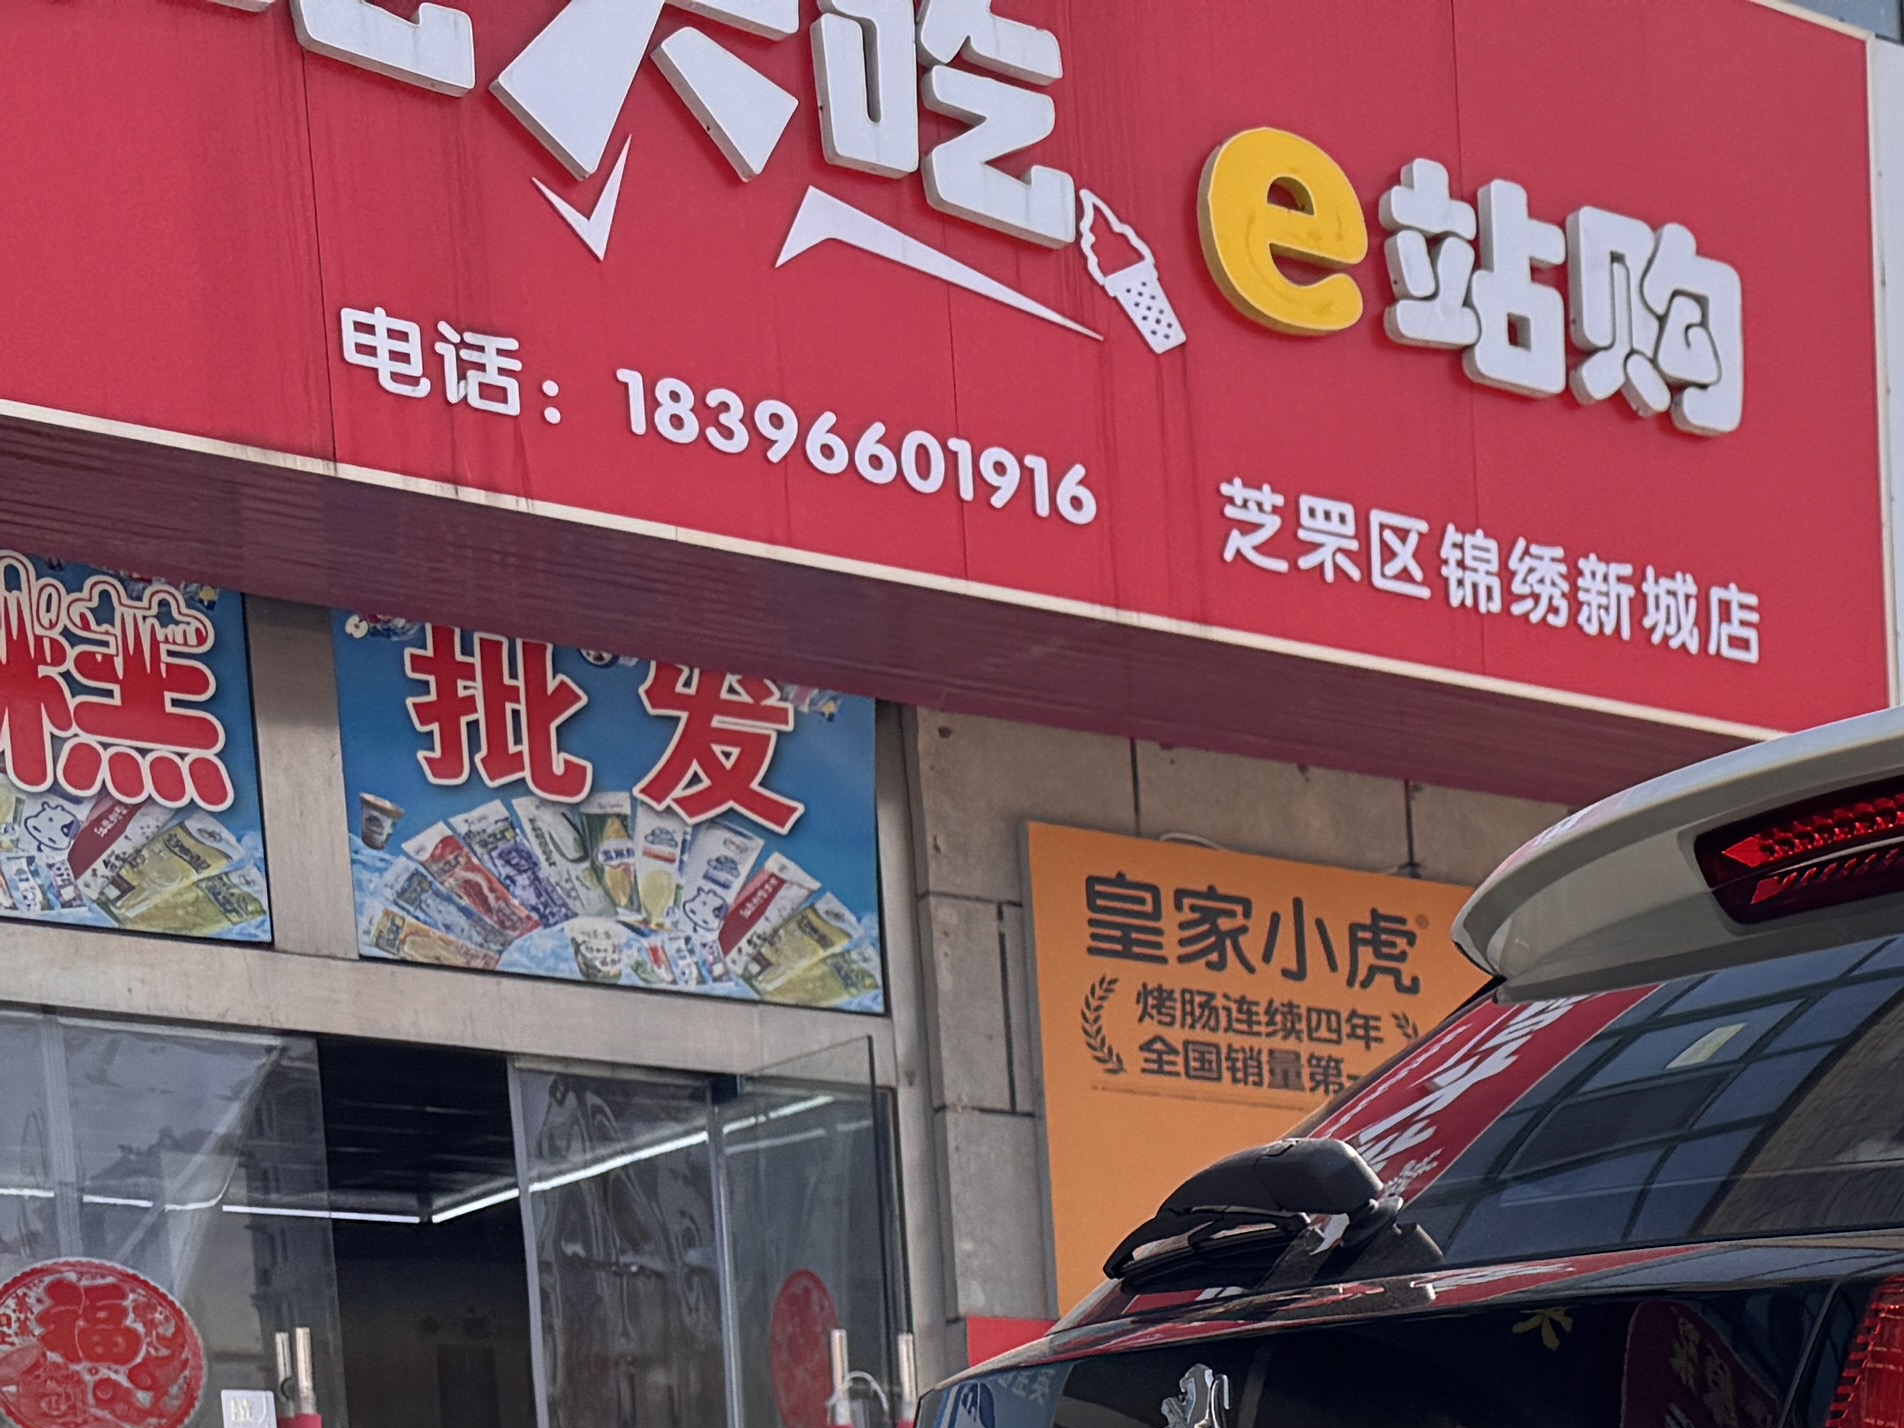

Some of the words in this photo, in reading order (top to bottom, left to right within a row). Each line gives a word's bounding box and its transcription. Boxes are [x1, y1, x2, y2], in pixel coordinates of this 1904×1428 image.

[616, 368, 1097, 525] 18396601916
[1219, 476, 1761, 664] 芝罘区锦绣新城店
[405, 622, 805, 836] 批发
[1084, 871, 1421, 996] 皇家小虎
[1135, 982, 1384, 1052] 烤肠连续四年
